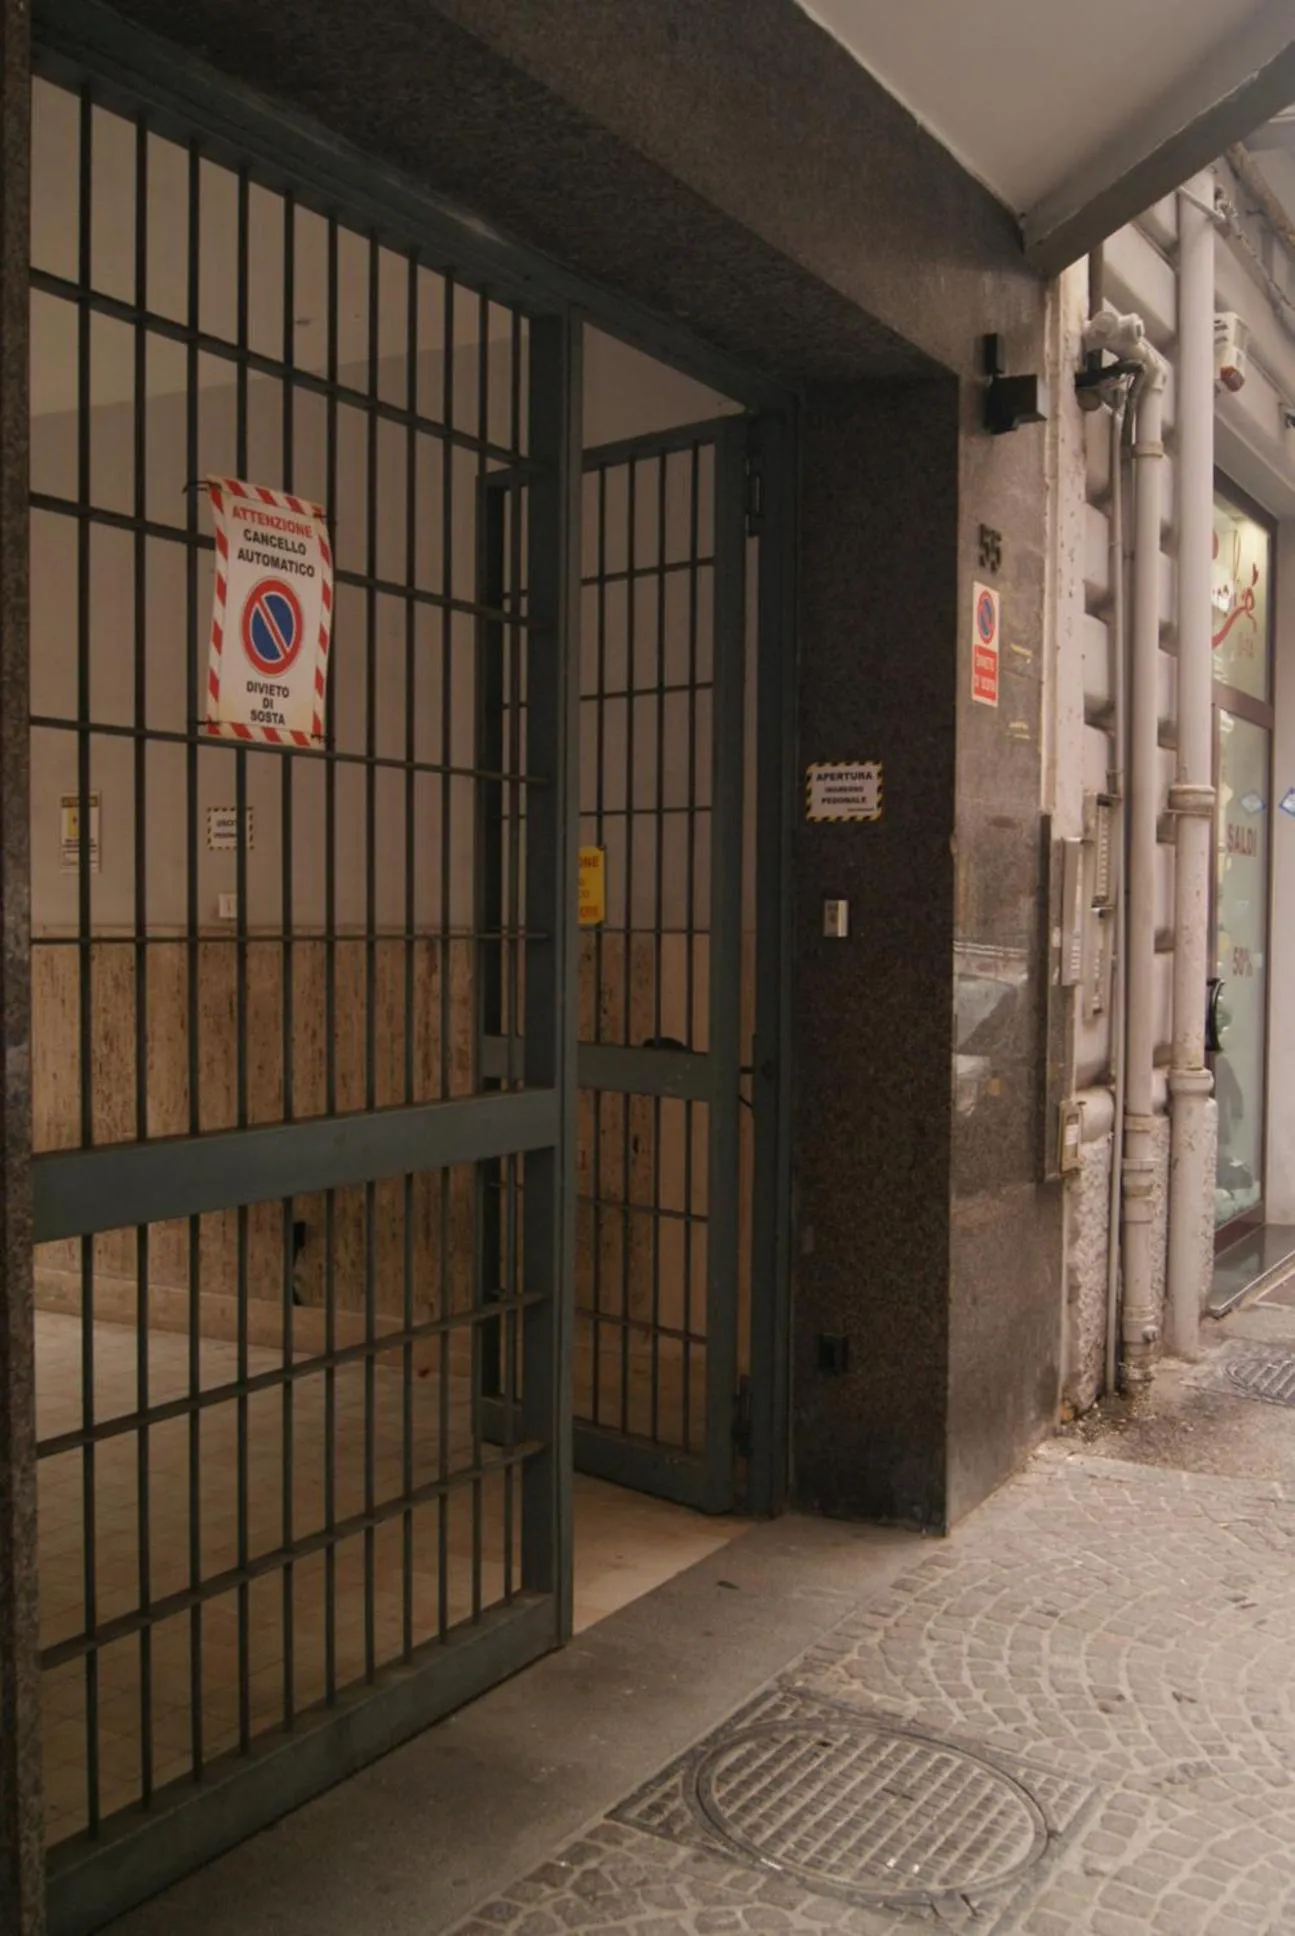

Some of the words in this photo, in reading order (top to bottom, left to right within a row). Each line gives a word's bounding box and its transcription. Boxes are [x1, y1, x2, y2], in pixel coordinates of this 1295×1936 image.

[232, 505, 313, 538] ATTENZIONE
[243, 528, 307, 555] CANCELLO
[237, 547, 315, 578] AUTOMATICO
[246, 680, 290, 698] DIVIETO
[262, 697, 274, 710] DI
[250, 710, 286, 725] SOSTA
[816, 772, 872, 782] APERTURA
[821, 797, 866, 805] PEDONALE
[1227, 824, 1257, 857] SALDI
